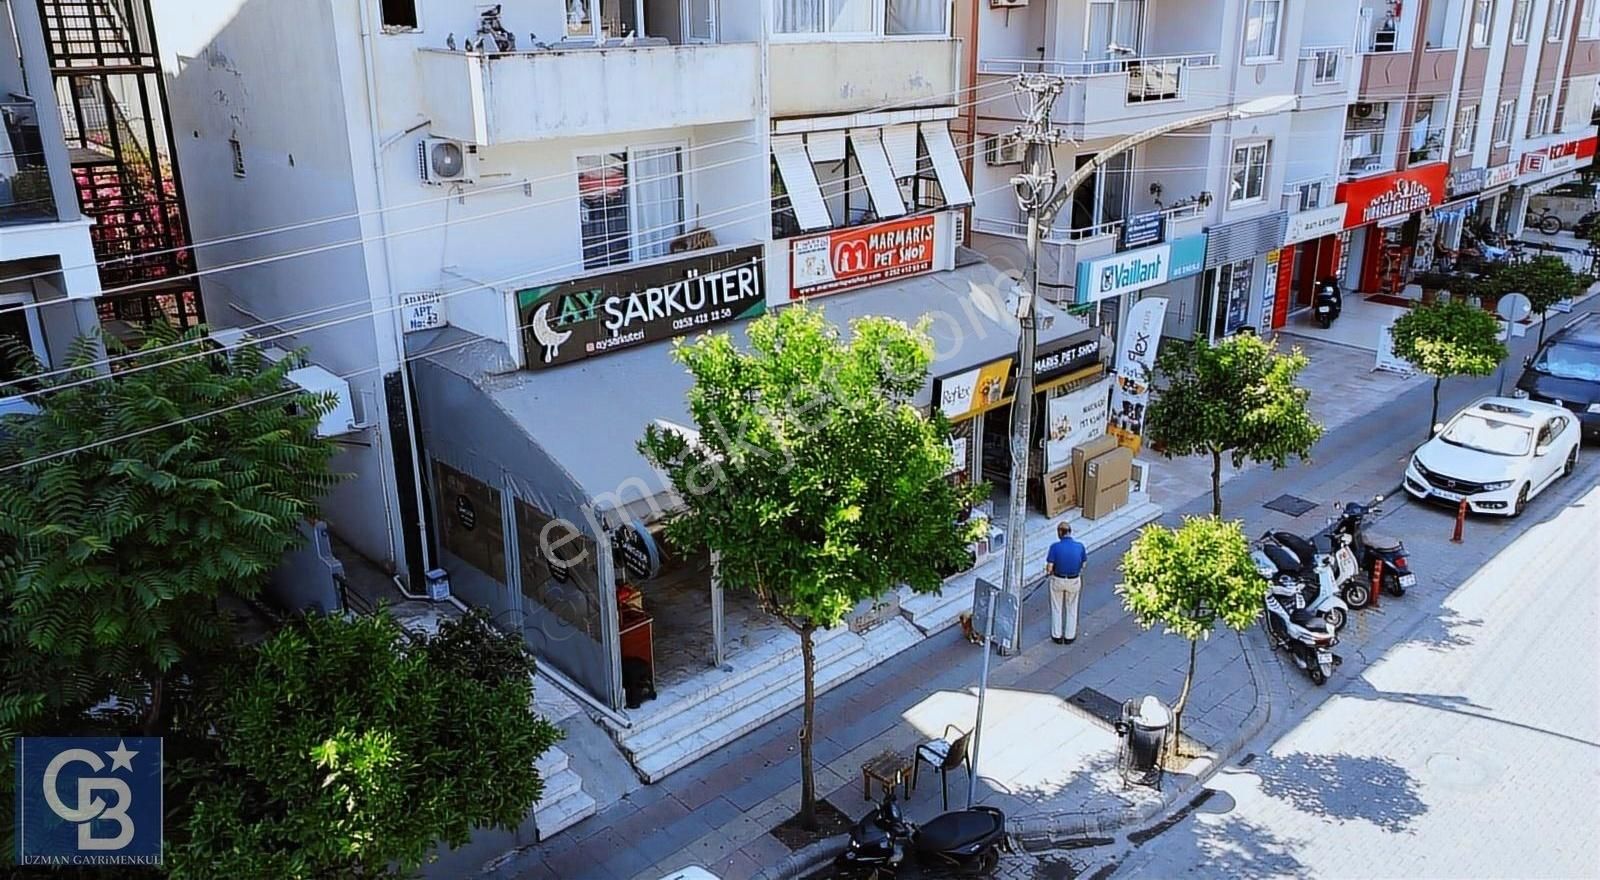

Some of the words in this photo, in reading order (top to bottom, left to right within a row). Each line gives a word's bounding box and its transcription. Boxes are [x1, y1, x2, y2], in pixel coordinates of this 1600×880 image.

[869, 224, 934, 250] MARMARIS
[874, 250, 897, 268] PET
[899, 244, 925, 263] SHOP
[1114, 254, 1162, 288] Vaillant
[557, 289, 603, 326] AY
[604, 256, 759, 337] ŞARKÜTERİ
[1060, 348, 1076, 363] PET
[1077, 341, 1098, 357] SHOP
